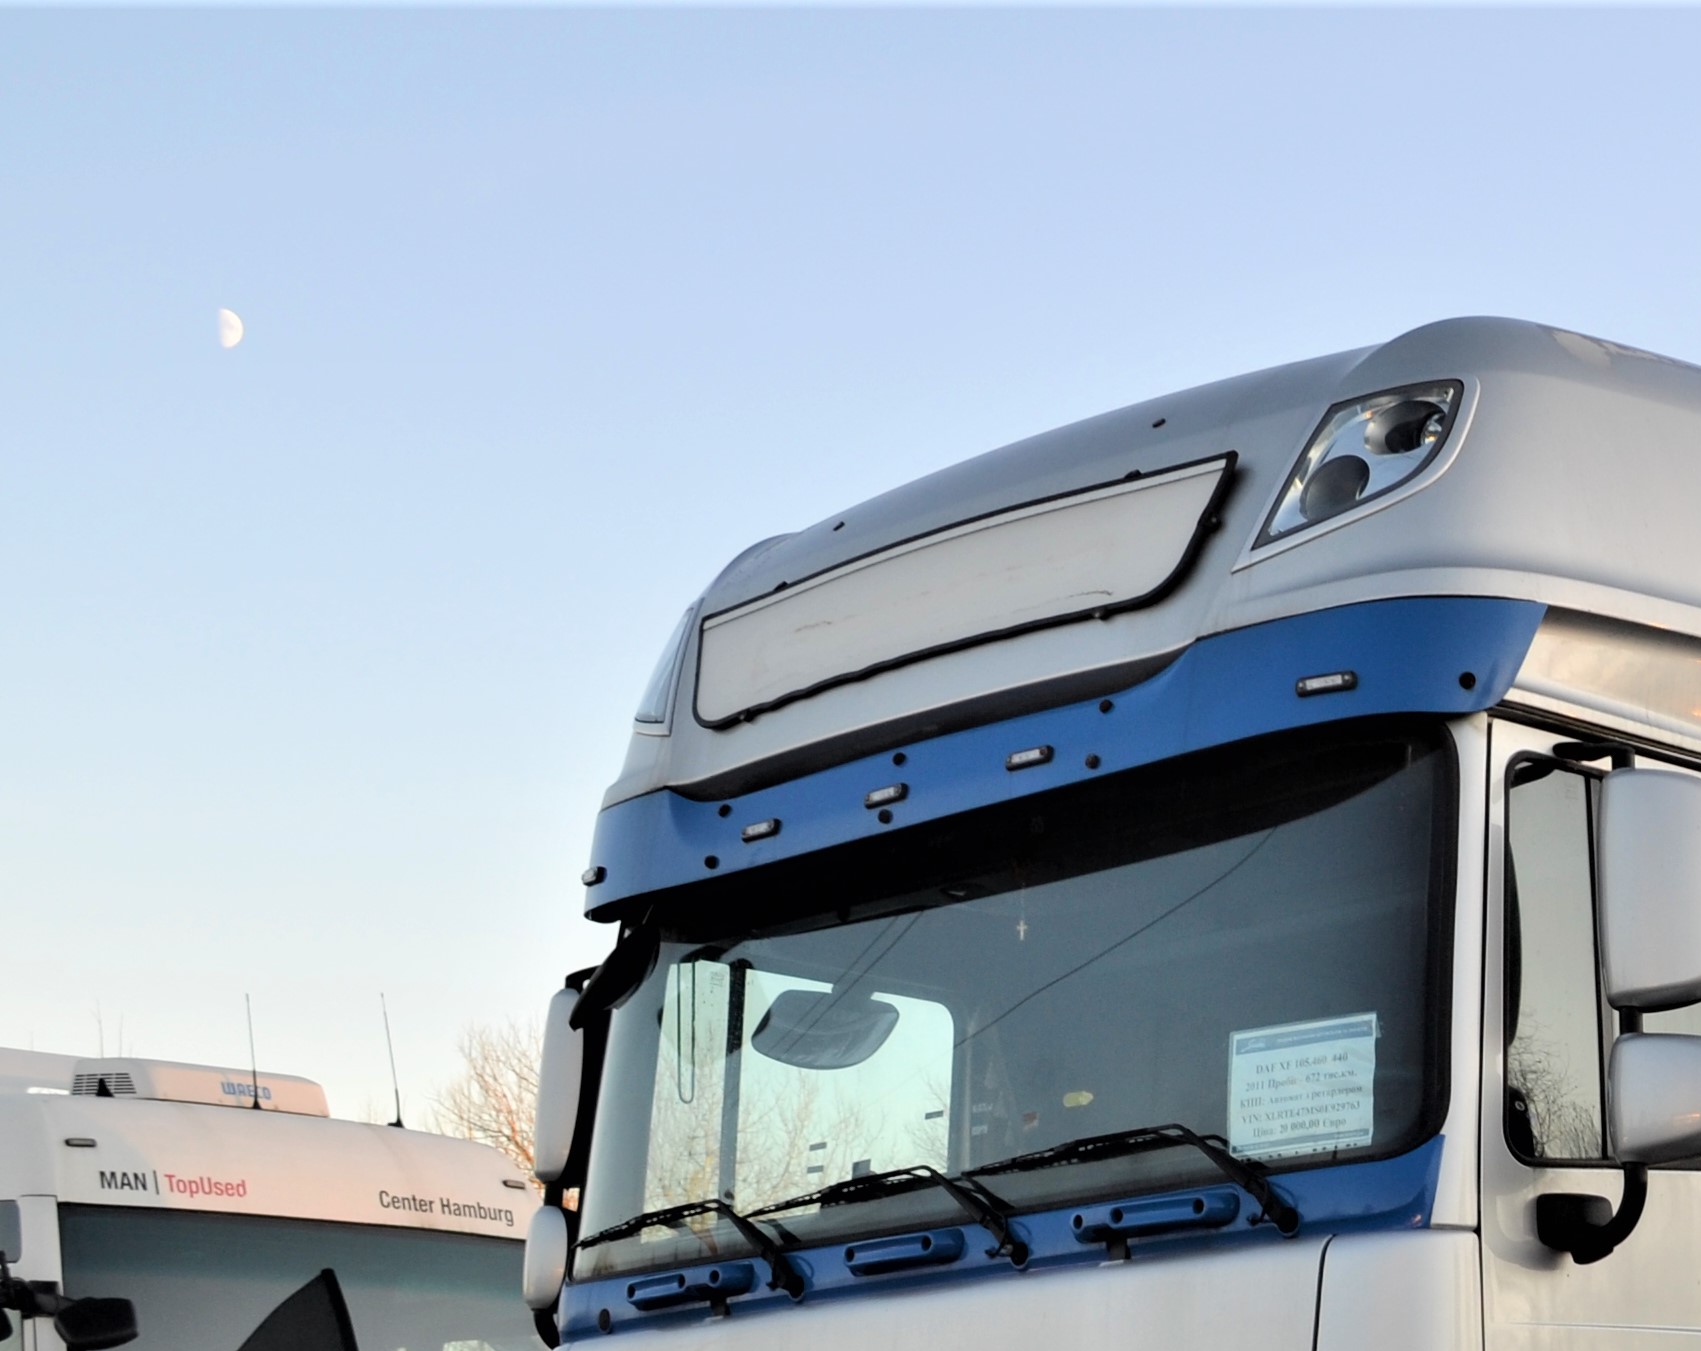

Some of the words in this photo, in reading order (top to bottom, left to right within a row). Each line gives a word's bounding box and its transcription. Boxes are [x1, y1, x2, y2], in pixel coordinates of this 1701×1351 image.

[99, 1170, 148, 1192] MAN
[164, 1173, 248, 1199] TopUsed
[378, 1189, 435, 1214] Center
[440, 1197, 515, 1227] Hamburg
